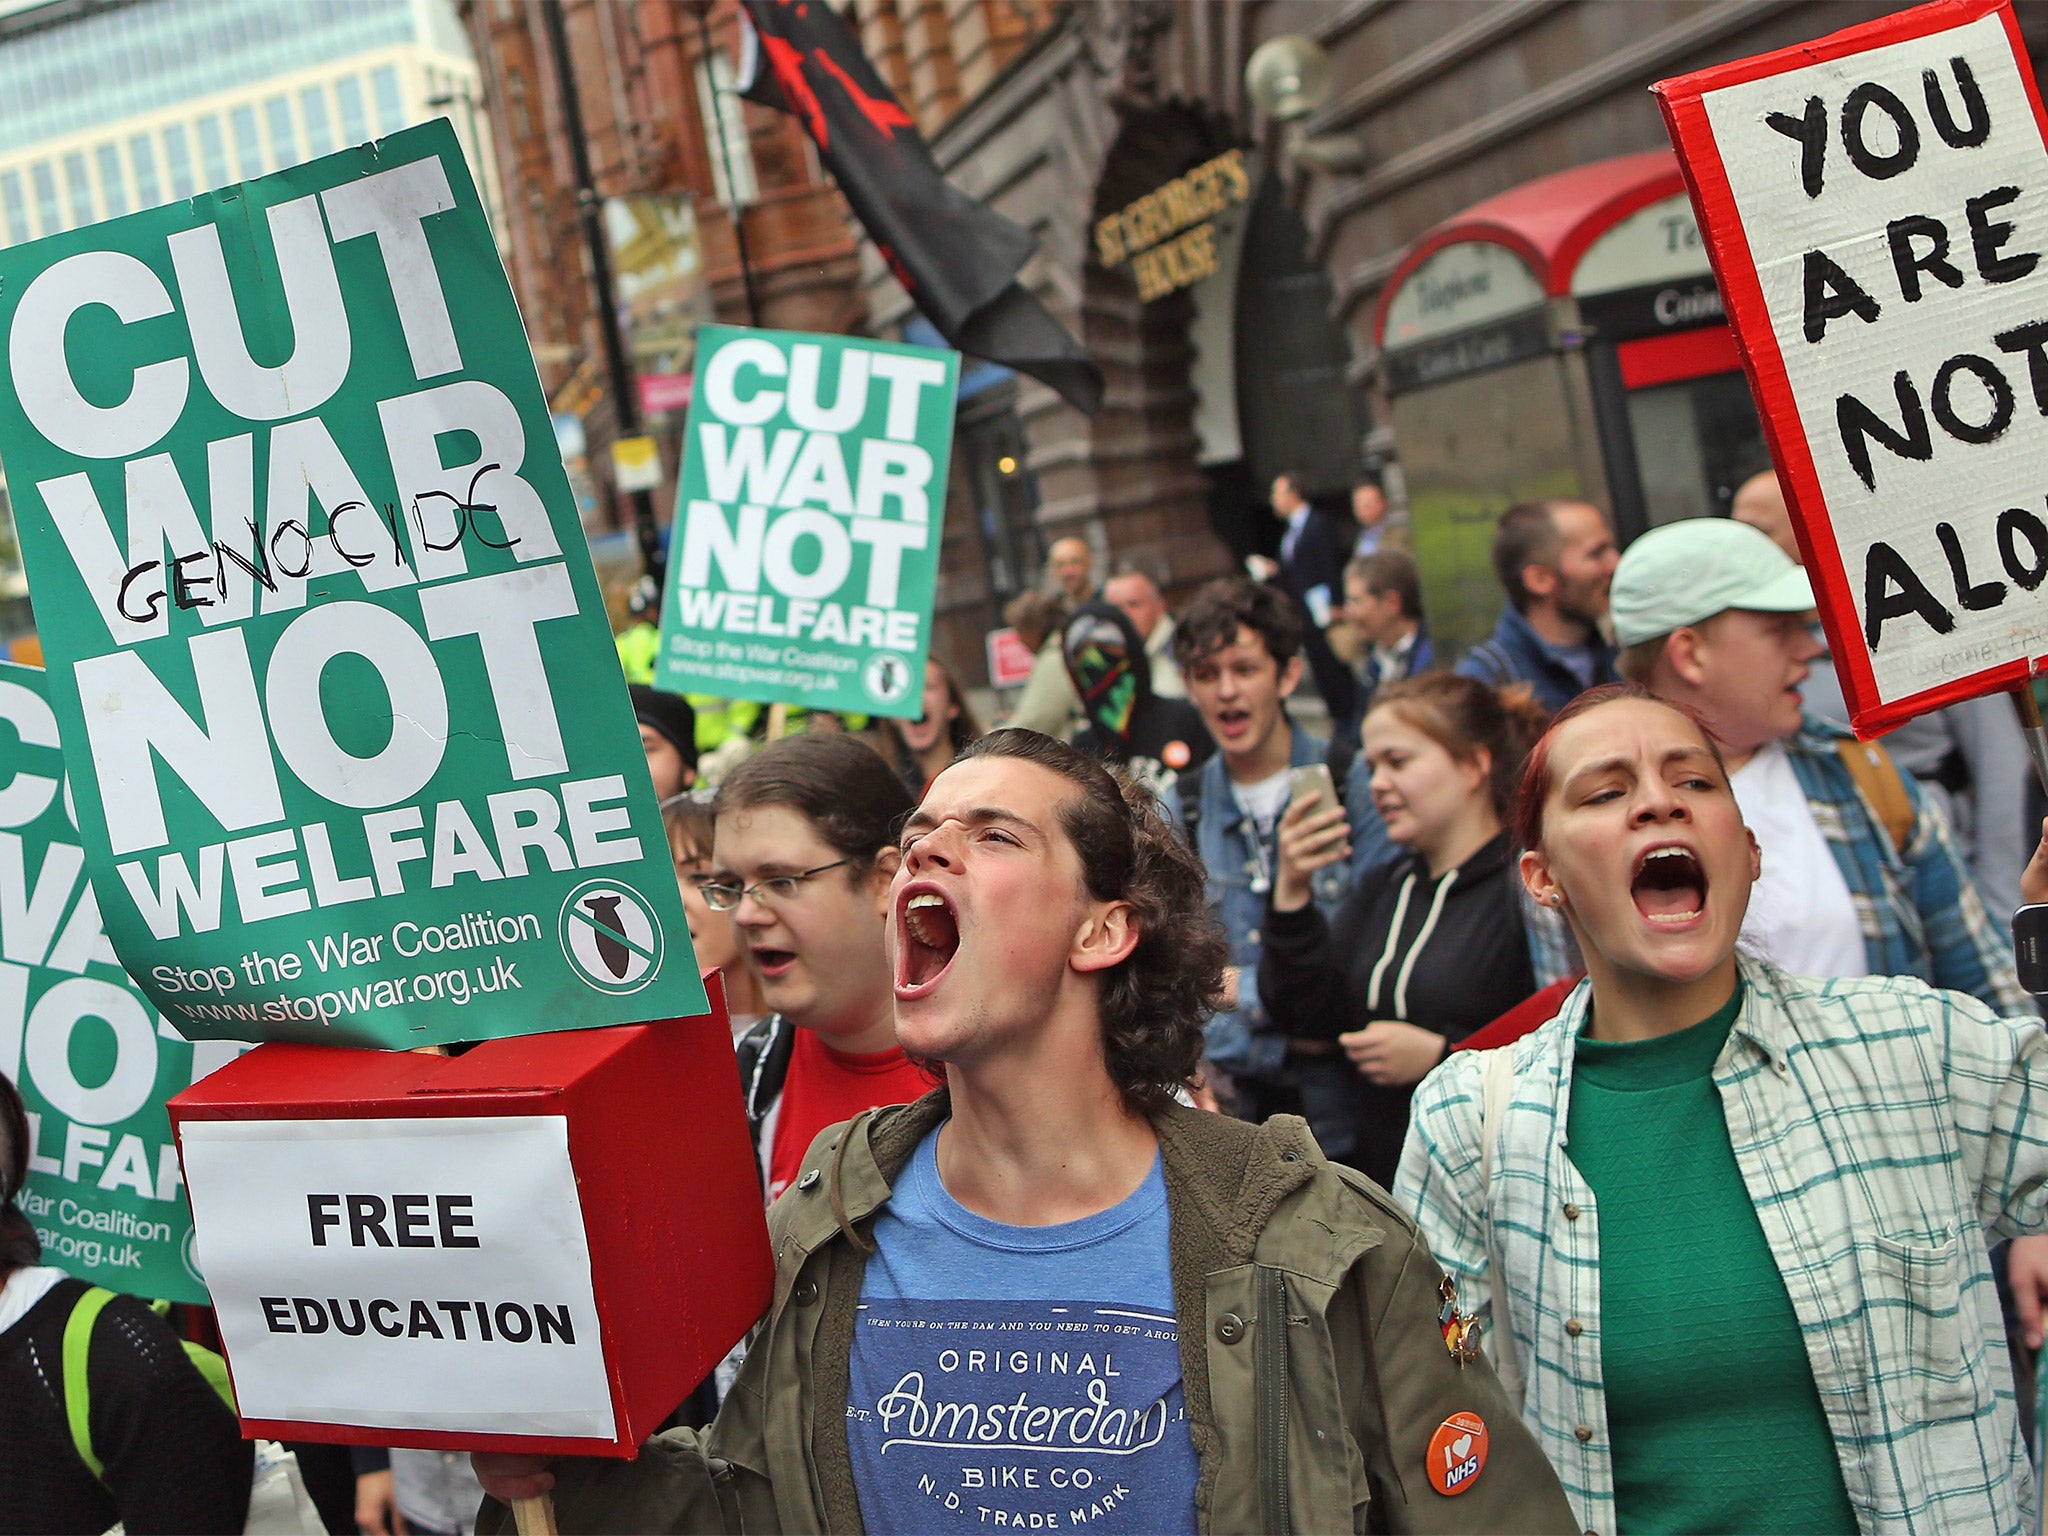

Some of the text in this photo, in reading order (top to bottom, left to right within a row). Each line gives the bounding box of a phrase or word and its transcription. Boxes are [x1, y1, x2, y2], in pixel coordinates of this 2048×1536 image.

[1764, 56, 1991, 199] YOU
[1803, 185, 2041, 344] ARE
[8, 153, 463, 459] CUT
[704, 338, 946, 442] CUT
[1836, 317, 2048, 493] NOT
[36, 380, 563, 646] WAR
[698, 422, 934, 524] WAR
[116, 463, 522, 623] GENOCIDE
[679, 499, 928, 609] NOT
[1864, 495, 2048, 653] ALO
[670, 633, 859, 673] Stop the War Coalition
[677, 587, 919, 652] WELFARE
[73, 560, 580, 856] NOT
[115, 774, 644, 941] WELFARE
[151, 910, 543, 998] Stop the War Coalition
[174, 954, 523, 1027] www.stopwar.org.uk
[58, 1197, 172, 1243] Coalition
[306, 1193, 482, 1250] FREE
[258, 1296, 577, 1346] EDUCATION
[929, 1321, 944, 1330] ON
[947, 1321, 969, 1330] THE
[971, 1322, 996, 1331] DAM
[999, 1321, 1024, 1331] AND
[1028, 1322, 1053, 1332] YOU
[1056, 1322, 1090, 1333] NEED
[1093, 1323, 1111, 1333] TO
[1114, 1325, 1141, 1336] GET
[938, 1349, 1121, 1377] ORIGINAL
[877, 1371, 1168, 1448] Amsterdam
[961, 1467, 1041, 1490] BIKE
[1444, 1444, 1453, 1469] I
[1446, 1455, 1478, 1489] NHS
[977, 1505, 1060, 1530] TRADE
[1070, 1482, 1132, 1526] MARK
